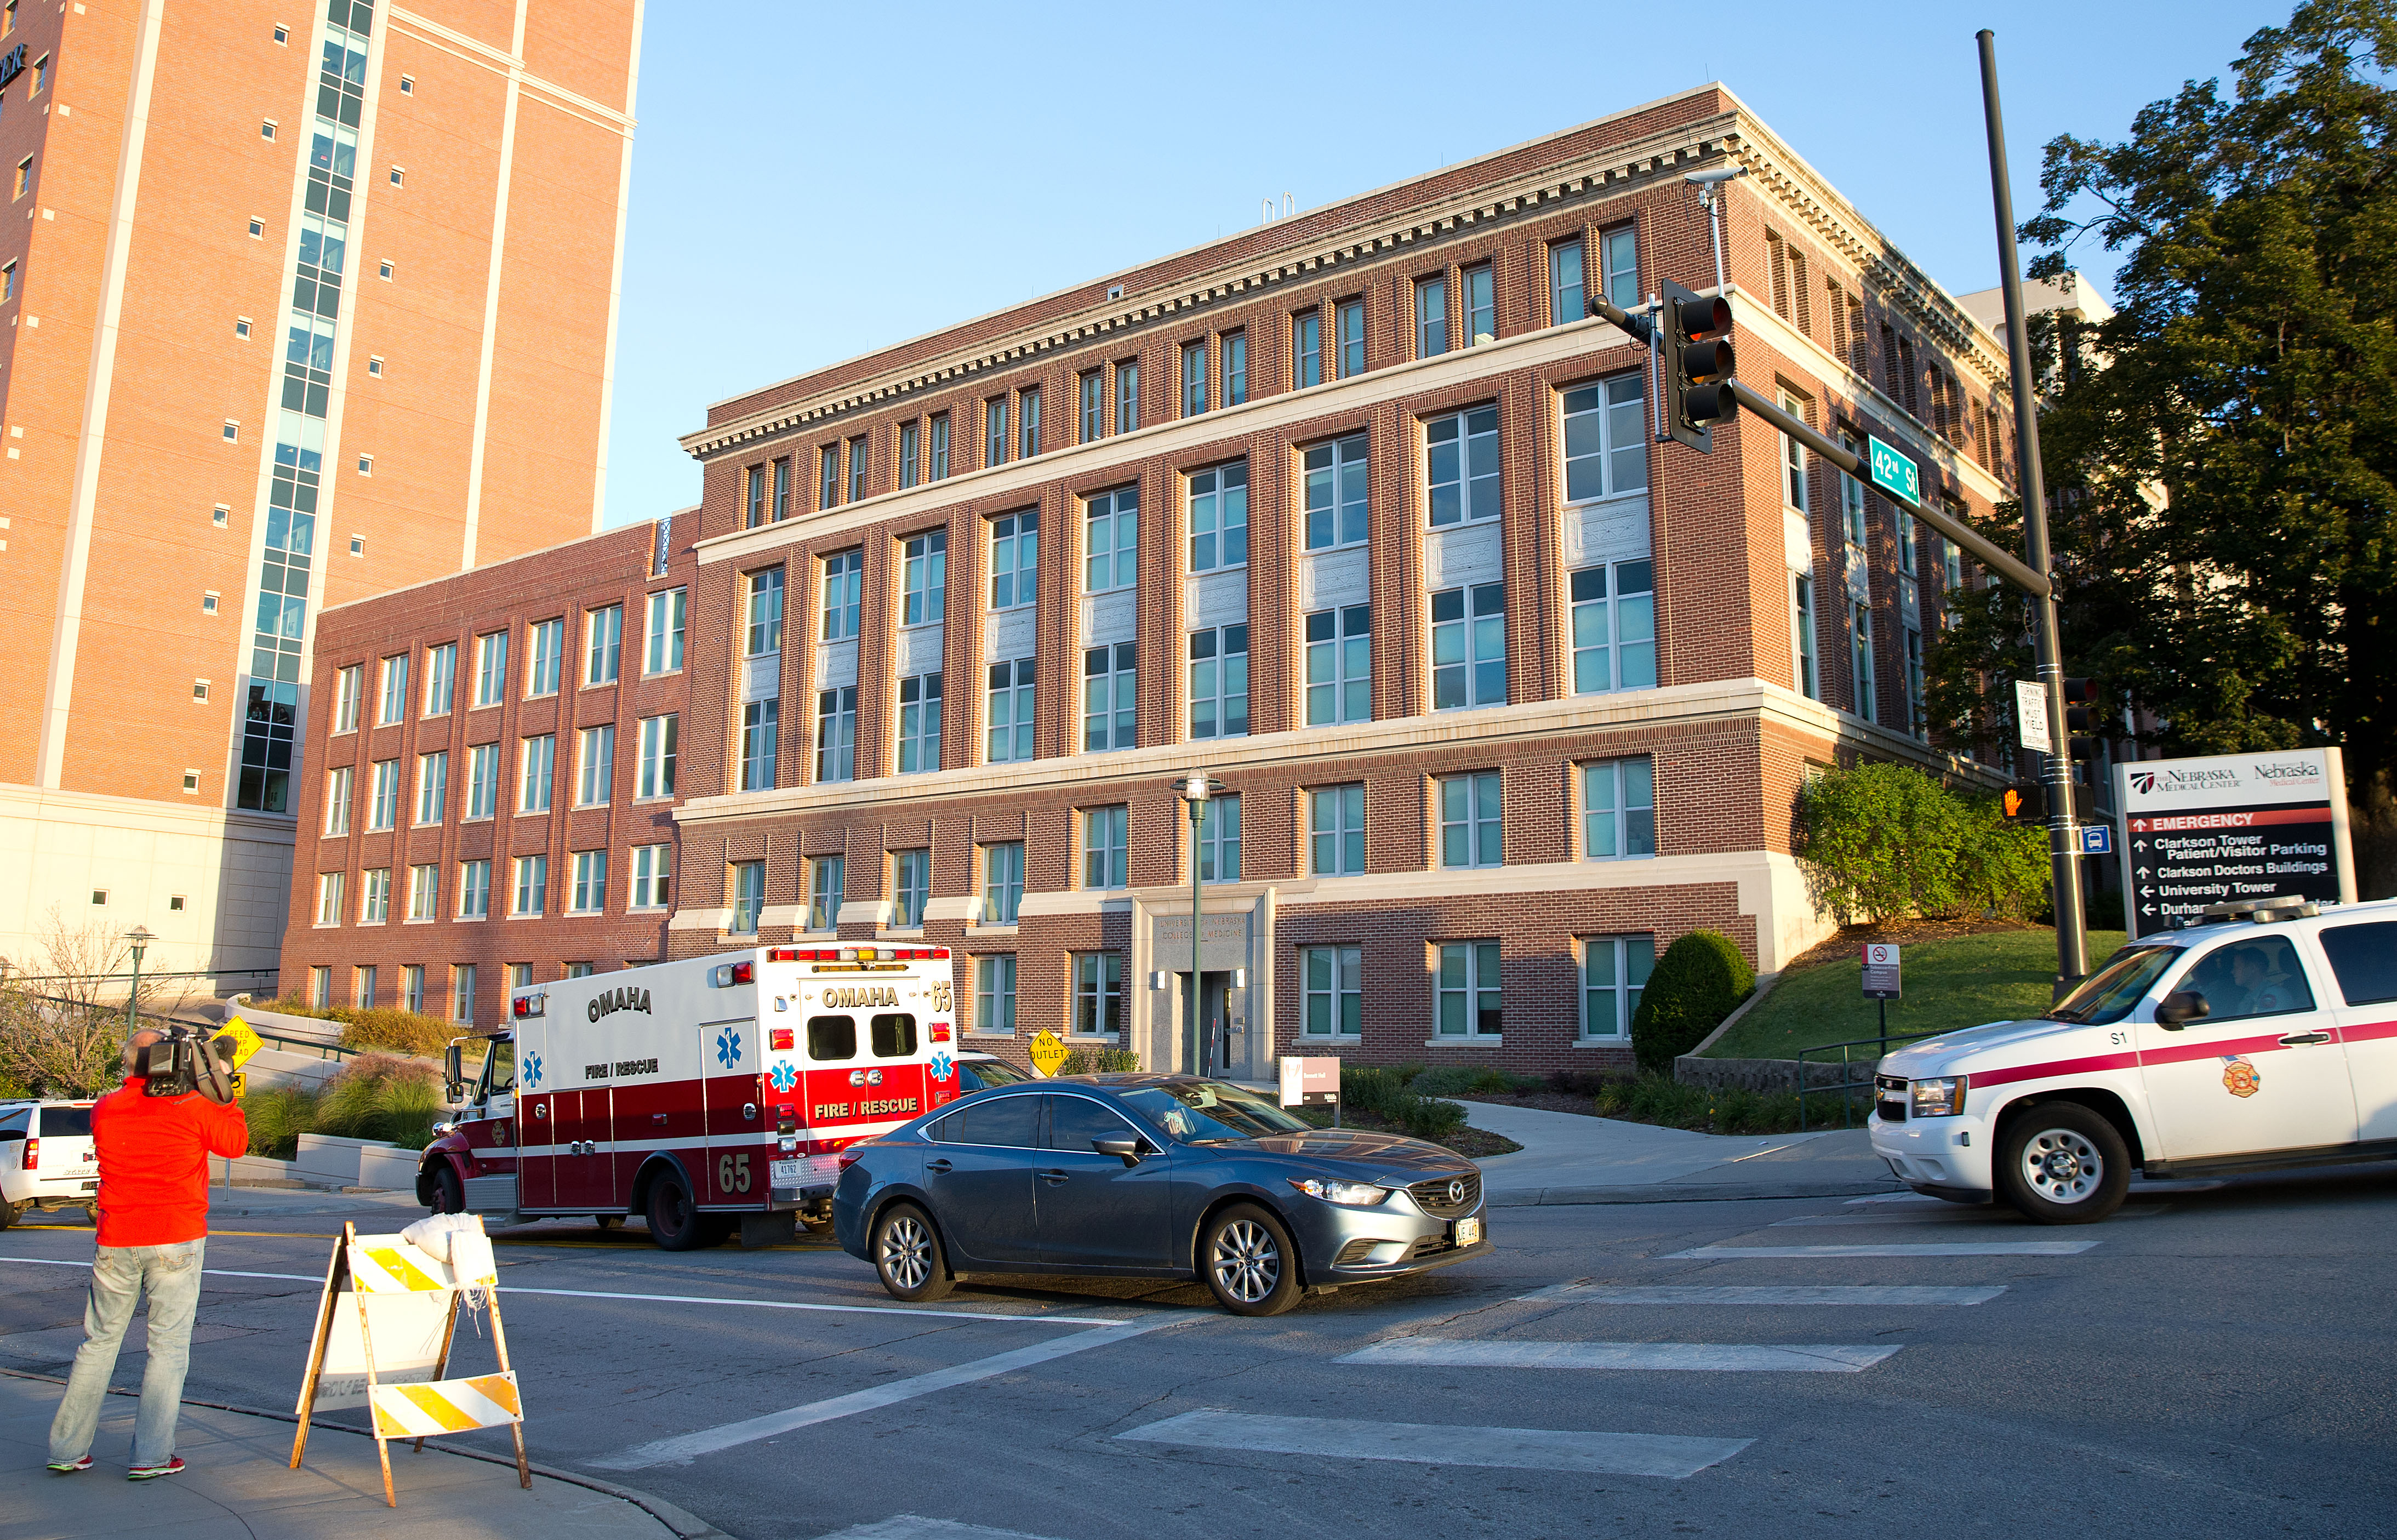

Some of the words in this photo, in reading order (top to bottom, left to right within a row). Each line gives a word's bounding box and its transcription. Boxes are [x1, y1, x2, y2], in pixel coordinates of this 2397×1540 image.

[1905, 467, 1916, 495] St
[2024, 708, 2040, 719] MUST
[2024, 719, 2043, 730] YIELD
[2167, 769, 2236, 782] NEBRASKA
[2253, 761, 2319, 779] Nebraska
[2156, 782, 2200, 792] MEDICAL
[2200, 779, 2241, 789] CENTER
[2269, 778, 2295, 786] Medical
[2153, 813, 2254, 830] EMERGENCY
[2154, 837, 2216, 849] Clarkson
[2218, 835, 2263, 846] Tower
[2167, 846, 2267, 860] Patient/Visitor
[2270, 842, 2327, 856] Parking
[2158, 866, 2212, 878] Clarkson
[2214, 864, 2264, 876] Doctors
[2266, 861, 2328, 875] Buildings
[2159, 883, 2230, 897] University
[2232, 882, 2277, 893] Tower
[1160, 919, 1193, 927] UNIVERSIT
[1212, 917, 1246, 926] NEBRASKA
[1162, 931, 1192, 939] COLLEGE
[1208, 929, 1241, 938] MEDICINE
[822, 987, 899, 1008] OMAHA
[931, 980, 952, 1012] 65
[588, 986, 652, 1023] OMAHA
[1039, 1037, 1053, 1047] NO
[2111, 1031, 2127, 1045] S1
[1030, 1049, 1064, 1060] OUTLET
[585, 1063, 608, 1080] FIRE
[615, 1058, 659, 1076] RESCUE
[815, 1102, 849, 1119] FIRE
[860, 1097, 918, 1116] RESCUE
[718, 1153, 752, 1194] 65
[781, 1165, 797, 1174] 41762
[318, 1378, 374, 1398] RIVE
